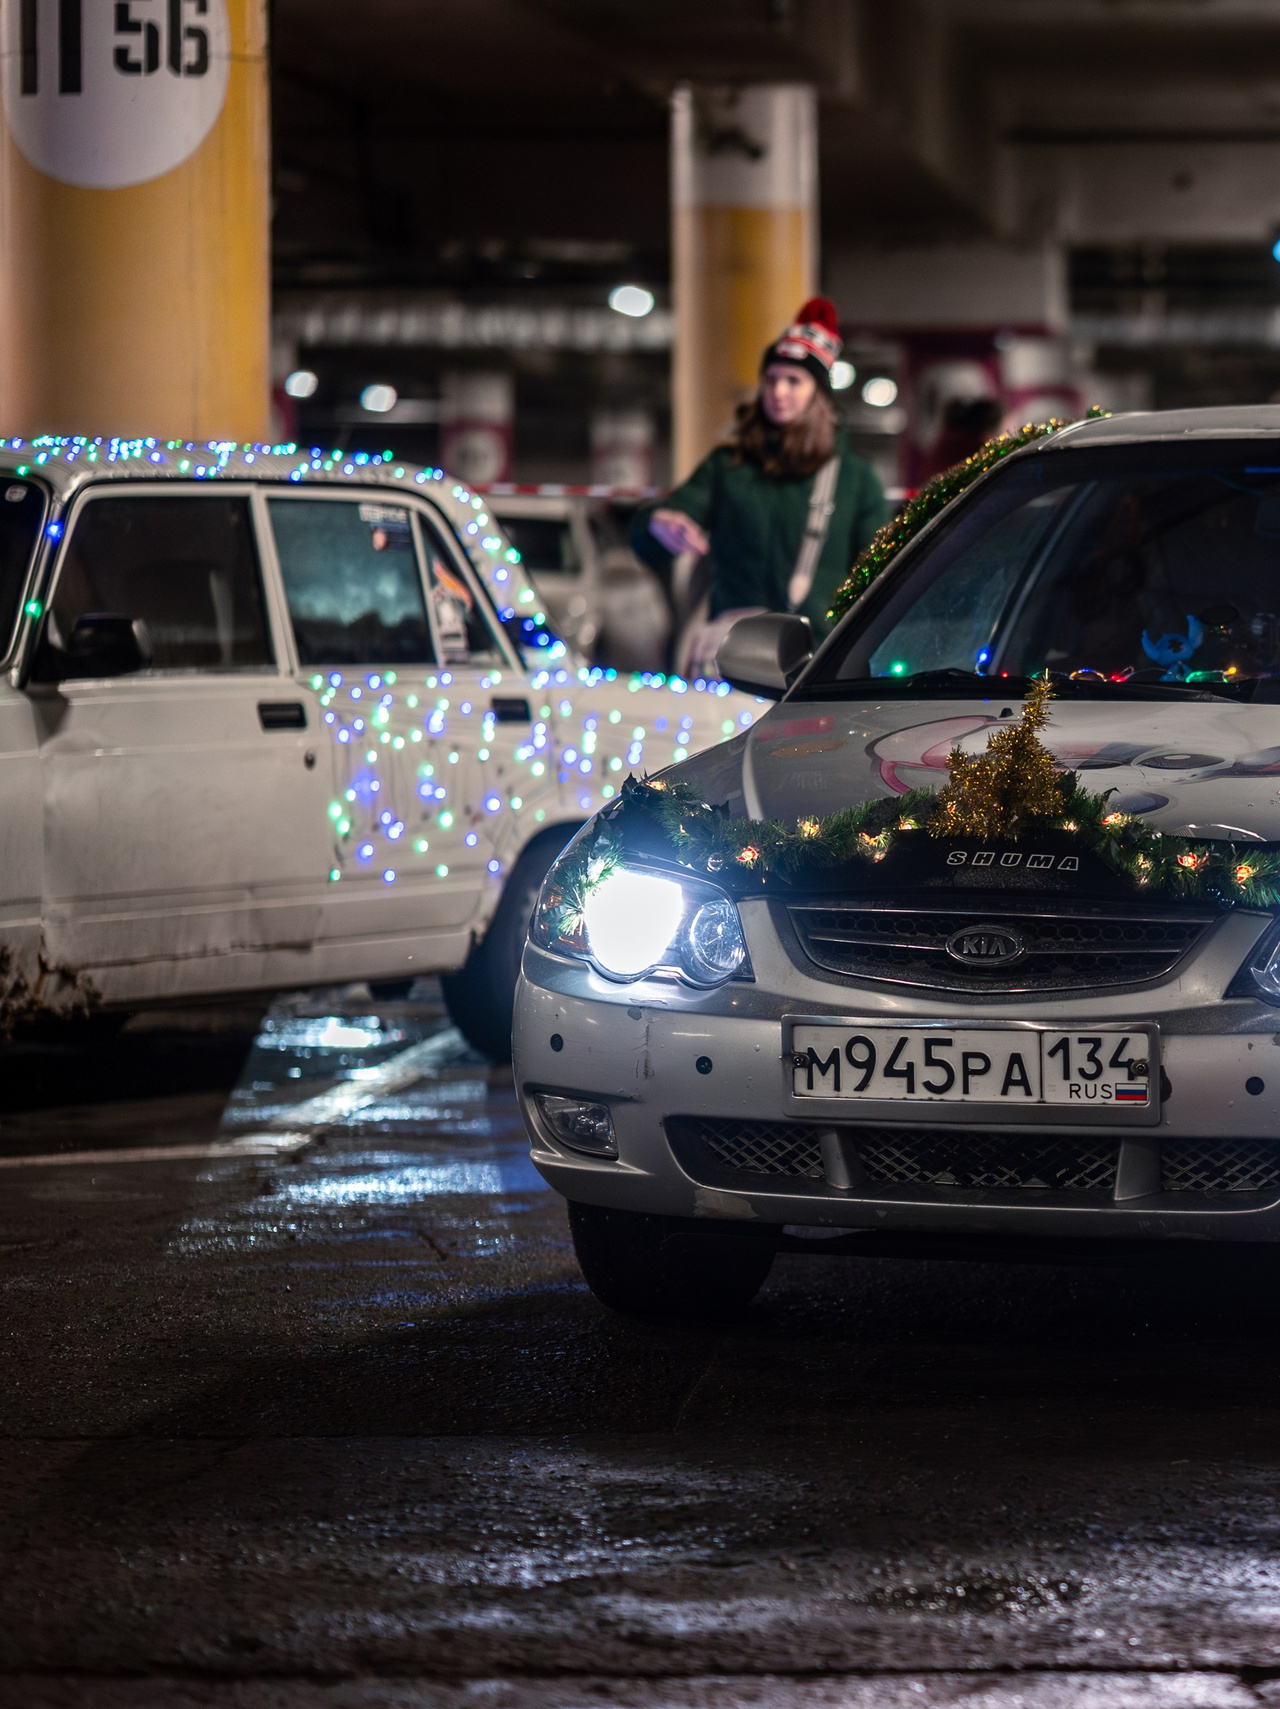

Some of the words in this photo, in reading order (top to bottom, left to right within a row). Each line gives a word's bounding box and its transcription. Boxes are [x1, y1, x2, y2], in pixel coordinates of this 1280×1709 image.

[113, 0, 210, 77] 56
[946, 851, 1079, 871] SHUMA
[962, 936, 1006, 955] KIA
[806, 1035, 1033, 1096] М945РА
[1047, 1036, 1136, 1081] 134
[1069, 1083, 1113, 1099] RUS
